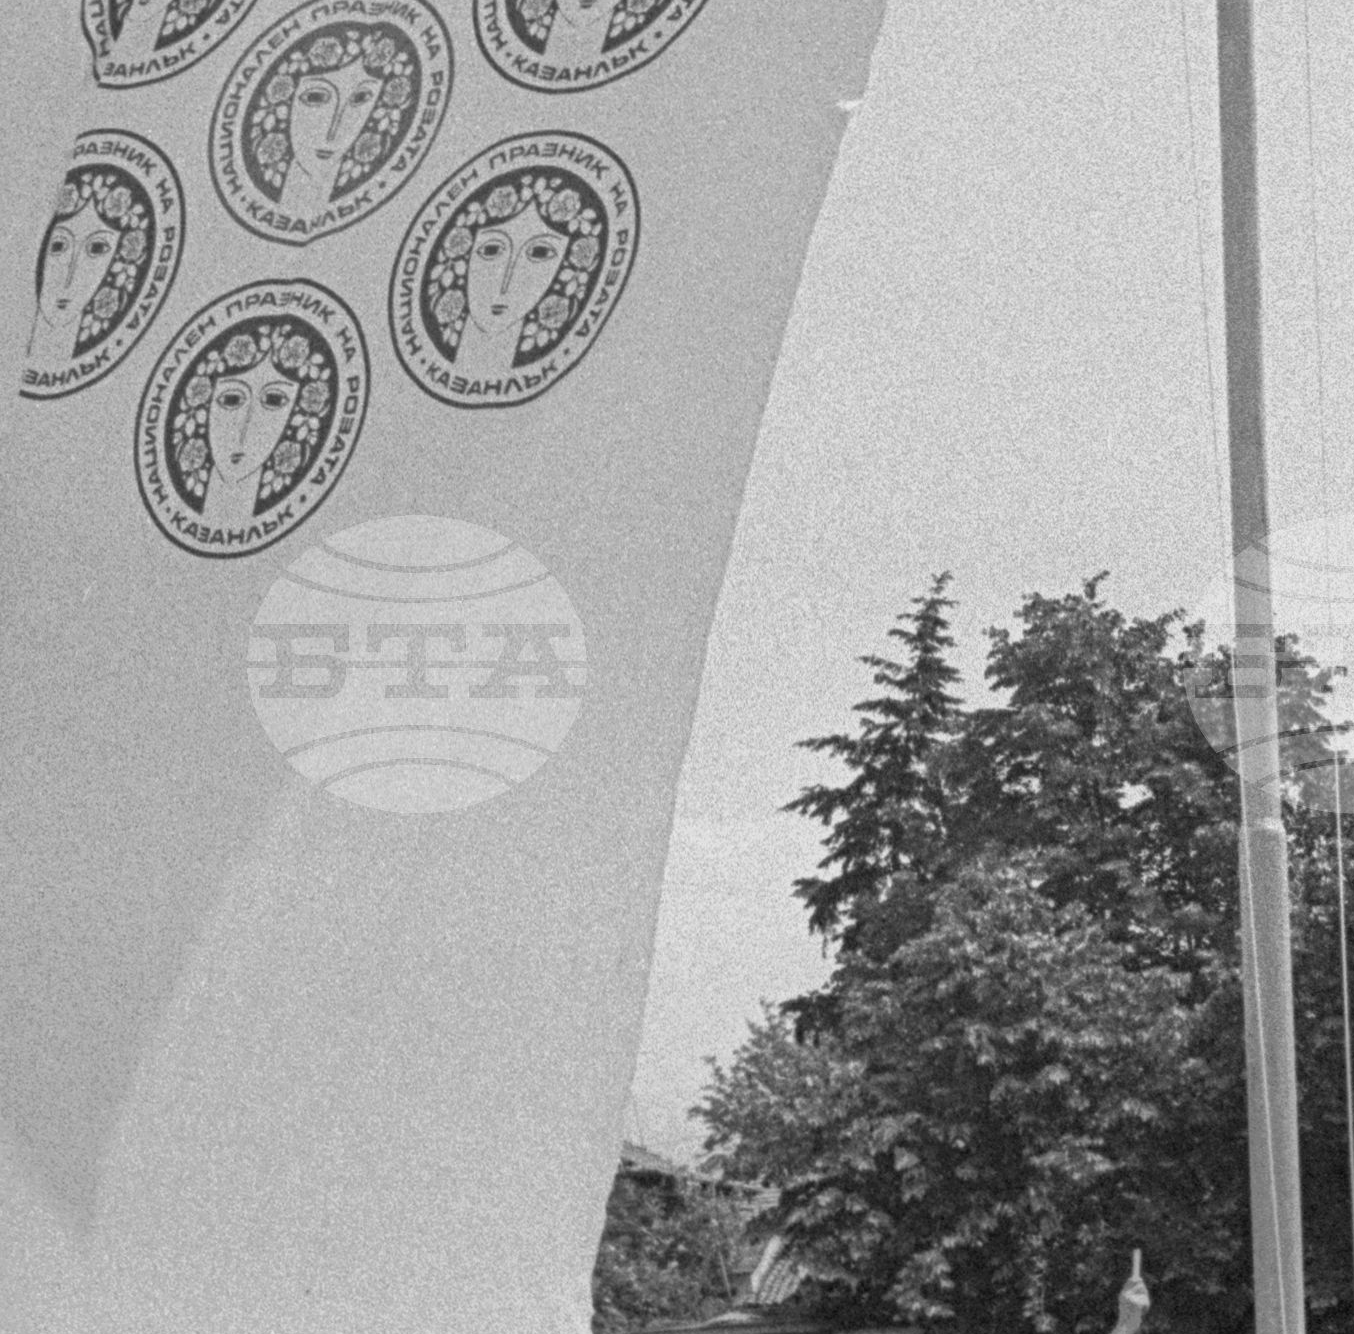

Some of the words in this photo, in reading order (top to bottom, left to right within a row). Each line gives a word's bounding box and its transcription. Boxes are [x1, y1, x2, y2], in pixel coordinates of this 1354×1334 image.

[311, 0, 421, 25] ПРАЗНИК
[103, 41, 196, 78] ЗАНЛЪК
[420, 25, 440, 61] НА
[511, 40, 649, 82] КАЗАНЛЪК
[220, 19, 301, 195] НАЦИОНАЛЕН
[390, 70, 443, 172] РОЗАТА
[73, 141, 157, 177] РАЗНИК
[489, 143, 609, 181] ПРАЗНИК
[156, 178, 174, 215] НА
[246, 191, 373, 234] КАЗАНЛЪК
[609, 182, 629, 217] НА
[126, 226, 175, 330] РОЗАТА
[400, 169, 478, 356] НАЦИОНАЛЕН
[575, 229, 629, 338] РОЗАТА
[225, 292, 336, 324] ПРАЗНИК
[336, 325, 356, 364] НА
[23, 347, 111, 387] ЗАНЛЪК
[426, 360, 559, 396] КАЗАНЛЪК
[144, 316, 216, 504] НАЦИОНАЛЕН
[310, 375, 360, 485] РОЗАТА
[171, 505, 294, 545] КАЗАНЛЪК
